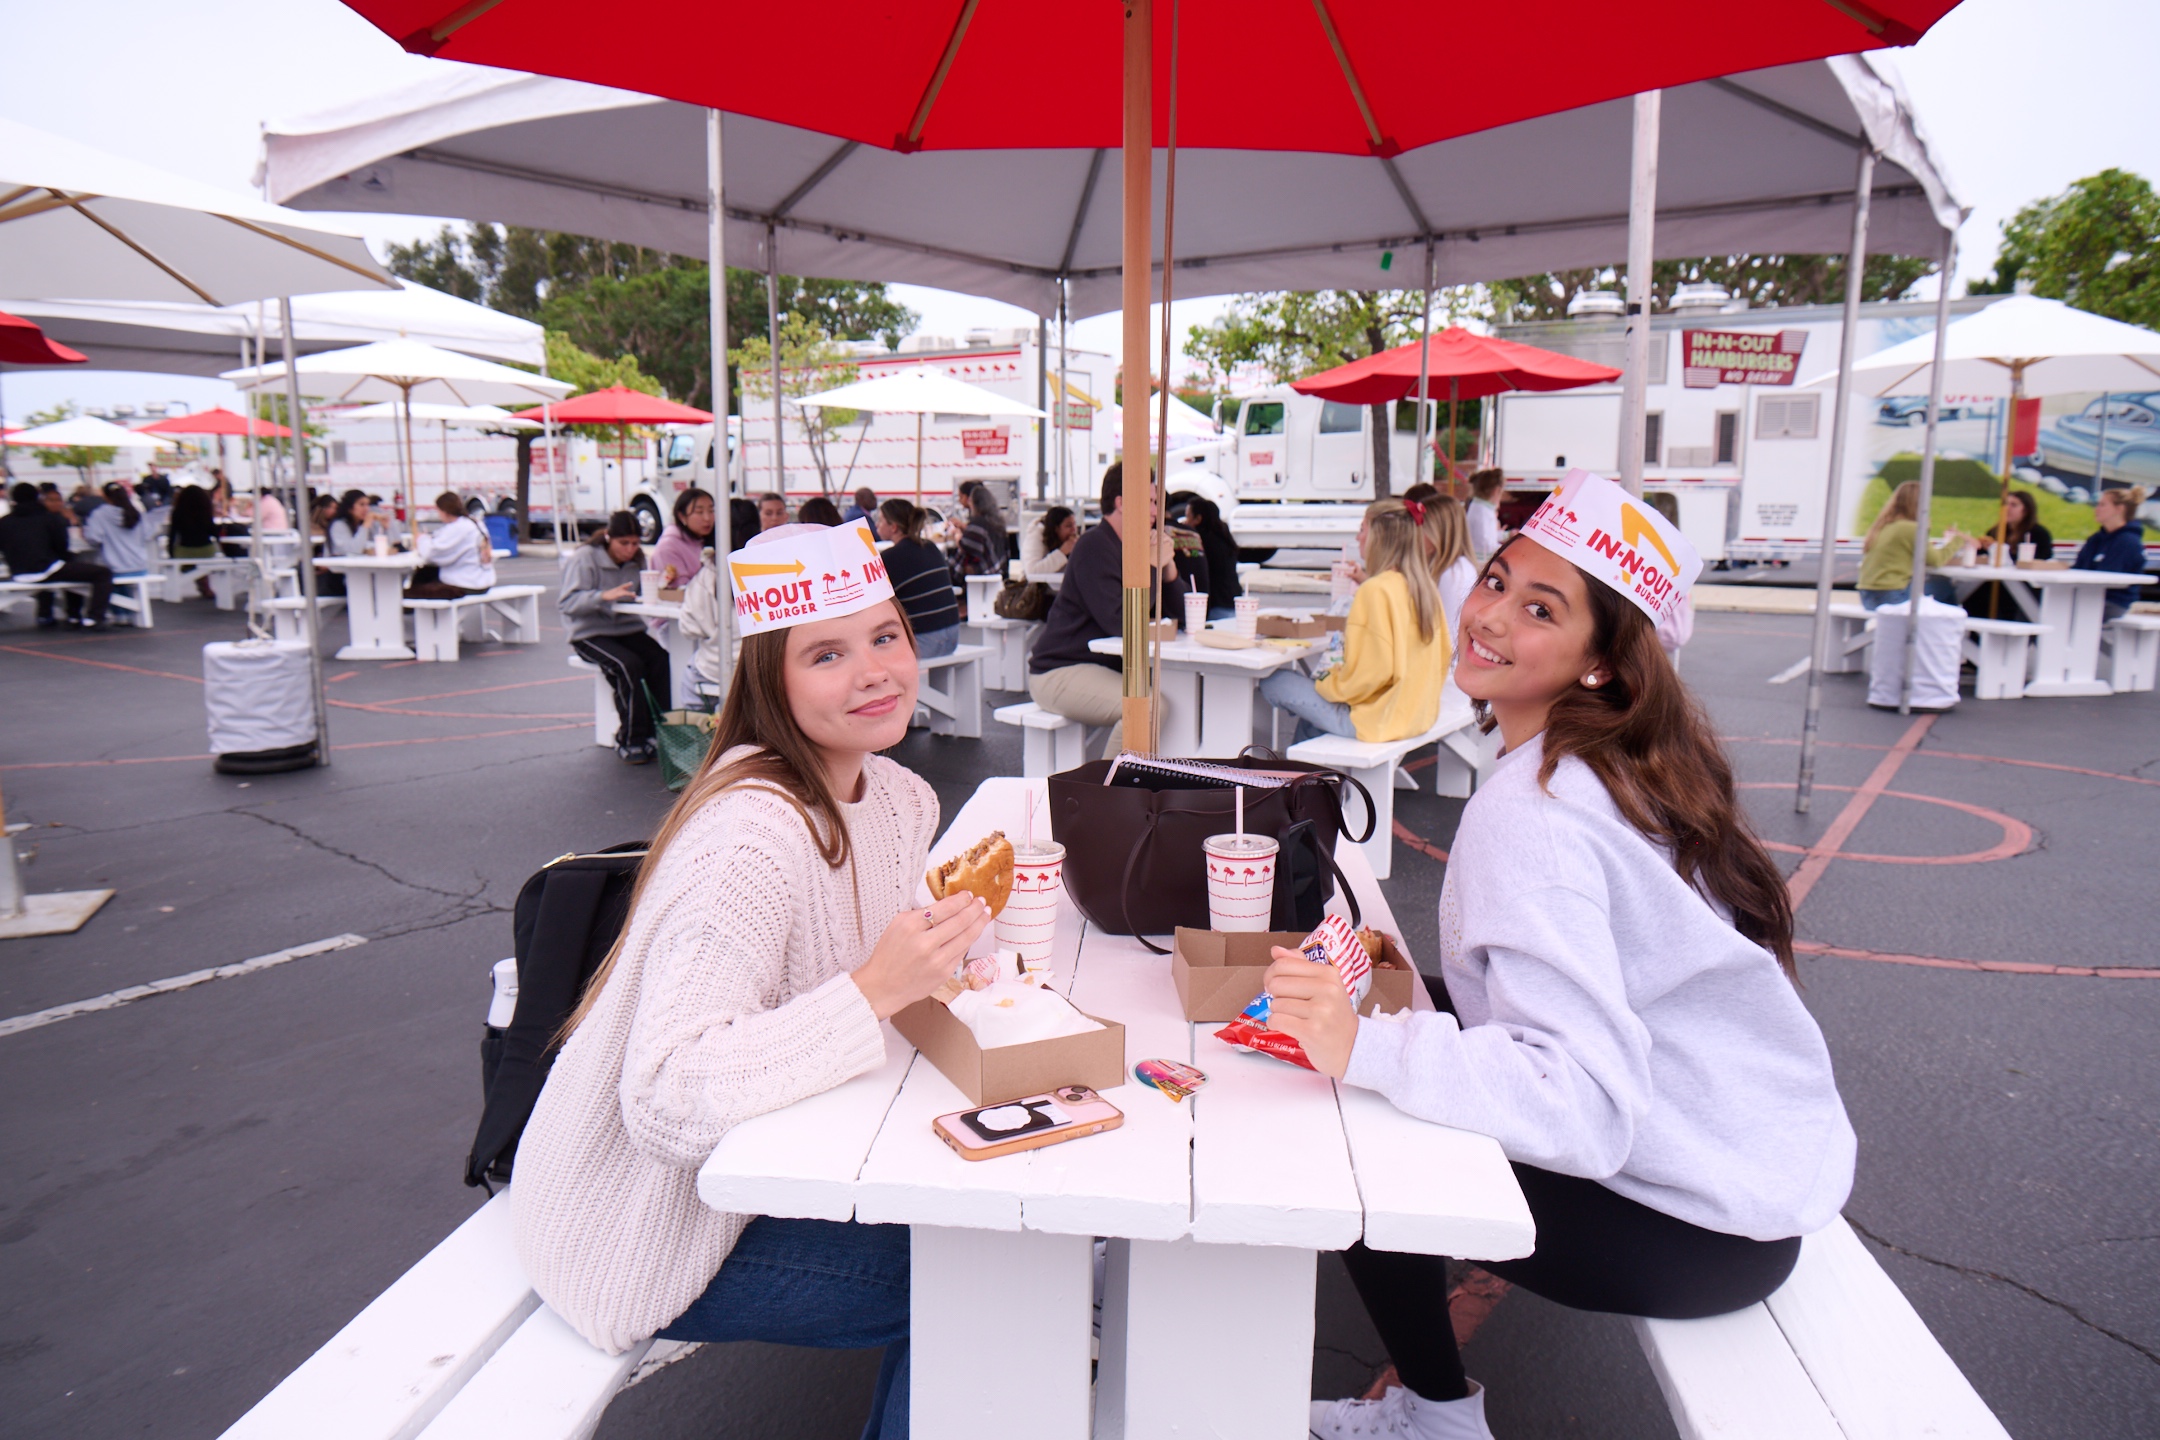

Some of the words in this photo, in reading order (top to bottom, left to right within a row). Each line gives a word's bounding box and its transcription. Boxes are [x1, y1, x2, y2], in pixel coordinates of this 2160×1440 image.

[1691, 332, 1775, 353] IN-N-OUT
[1690, 349, 1794, 372] HAMBURGERS
[1586, 528, 1674, 601] IN-N-OUT
[735, 580, 813, 616] IN-N-OUT
[1634, 583, 1662, 612] BURGER
[768, 602, 818, 621] BURGER
